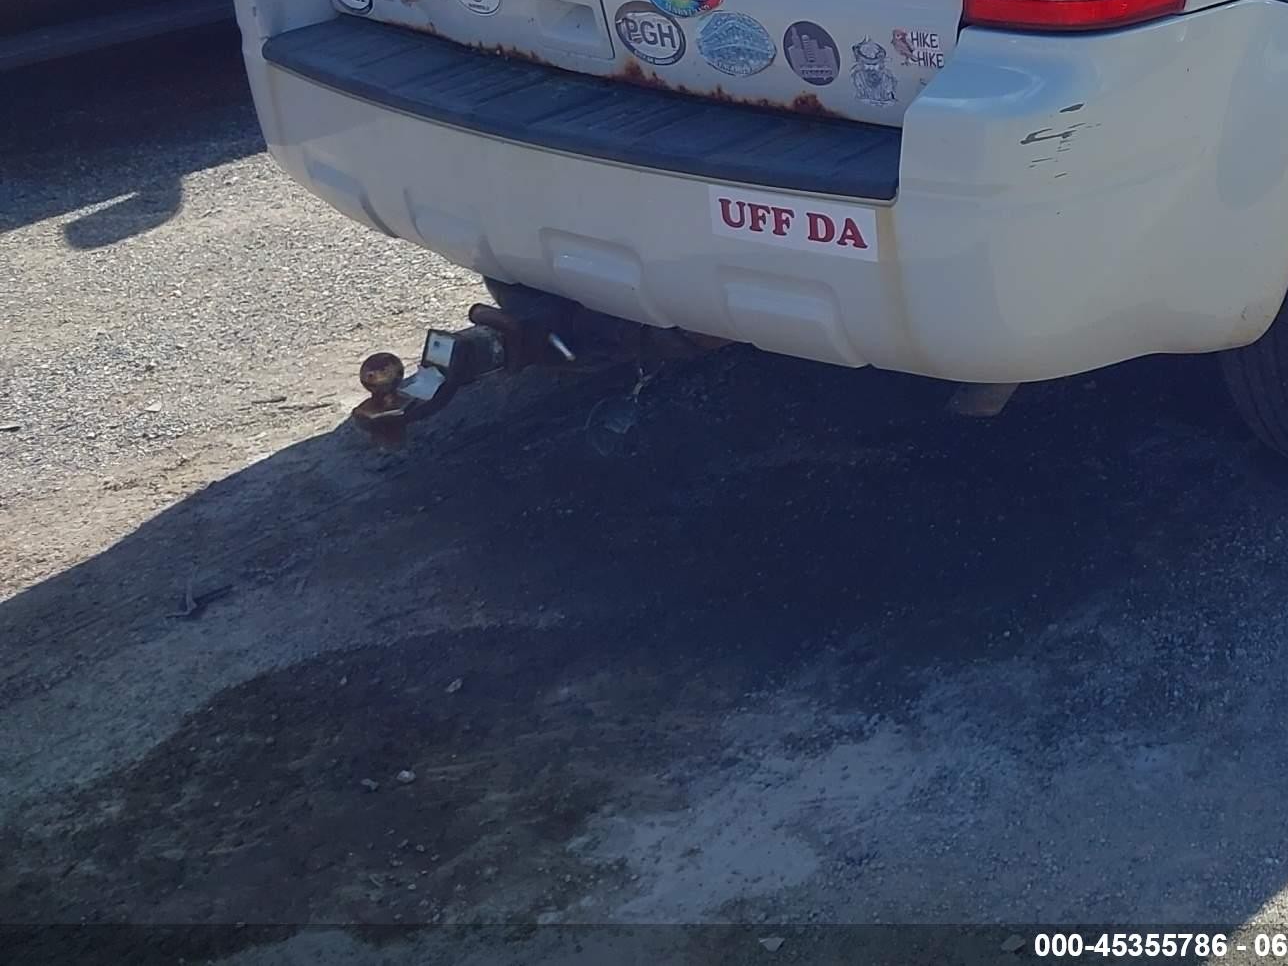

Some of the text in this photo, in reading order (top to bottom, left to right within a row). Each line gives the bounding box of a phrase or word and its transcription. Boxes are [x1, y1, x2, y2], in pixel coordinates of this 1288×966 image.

[622, 18, 676, 49] PGH
[910, 31, 939, 49] HIKE
[917, 51, 945, 69] HIKE
[718, 198, 868, 249] UFF DA
